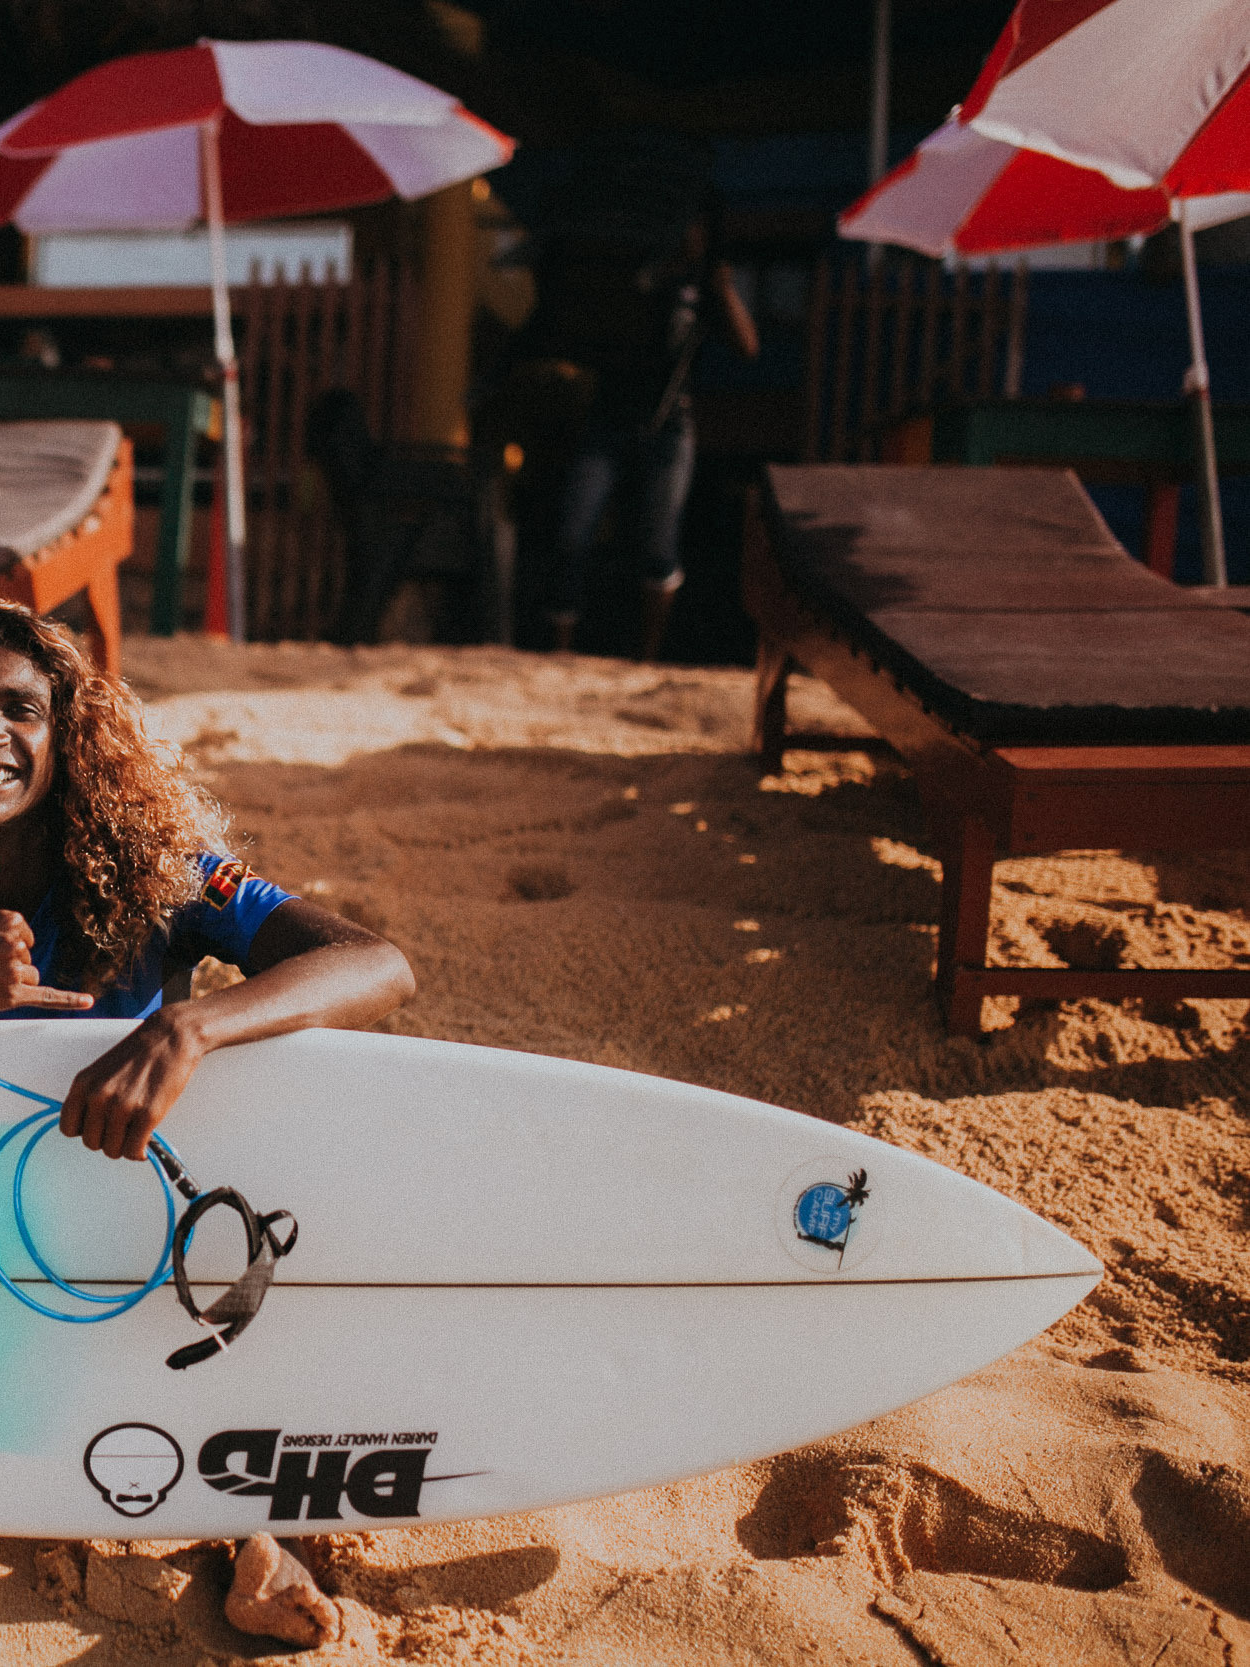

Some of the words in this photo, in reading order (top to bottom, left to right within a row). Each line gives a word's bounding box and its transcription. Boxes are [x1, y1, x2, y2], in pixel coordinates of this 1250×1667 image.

[282, 1433, 333, 1448] DESIGNS
[333, 1432, 389, 1446] HANDLEY
[392, 1431, 439, 1444] DARREN
[197, 1429, 433, 1520] DHD
